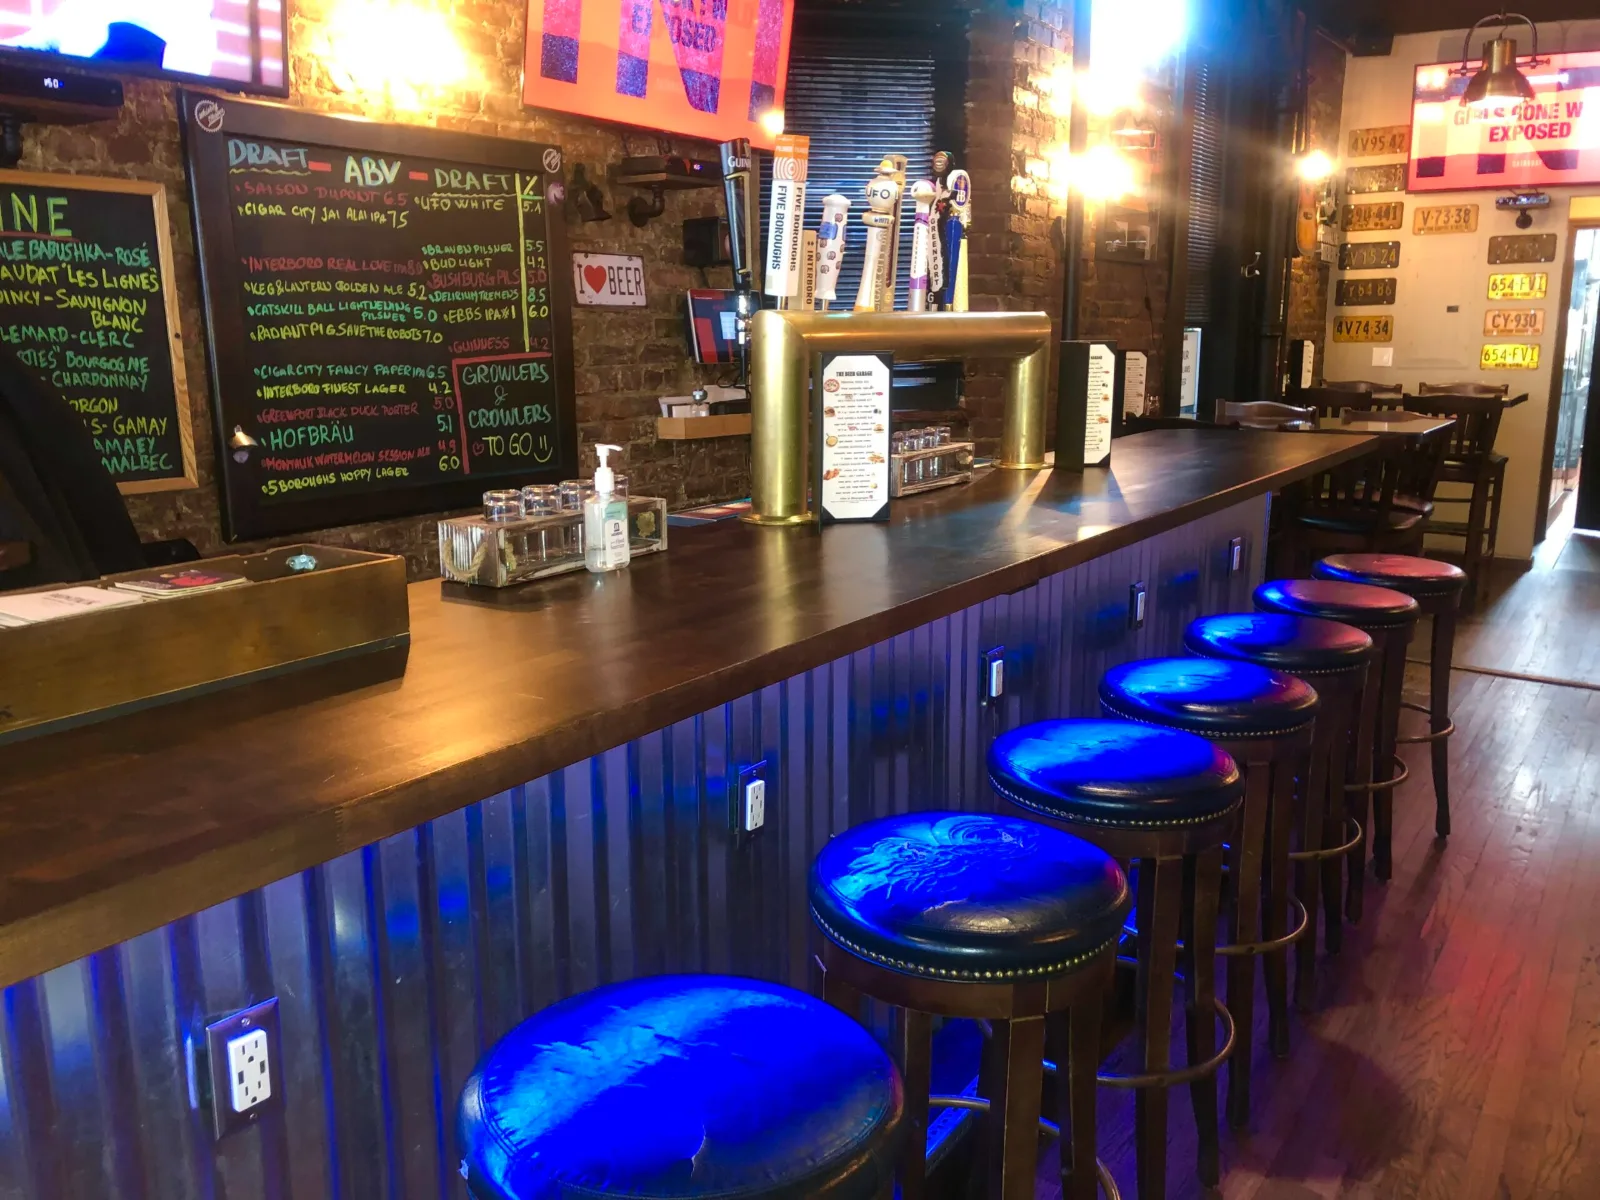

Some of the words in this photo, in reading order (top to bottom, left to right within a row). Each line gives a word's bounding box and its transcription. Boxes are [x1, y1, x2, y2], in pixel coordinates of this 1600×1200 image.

[1489, 122, 1572, 142] EXPOSED
[228, 139, 309, 169] DRAFT
[344, 155, 401, 187] ABV
[434, 168, 511, 191] DRAFT
[523, 175, 538, 195] %
[244, 181, 309, 196] SAISON
[314, 186, 380, 203] DUPONT
[776, 185, 788, 210] FIVE
[866, 186, 891, 200] UFO
[244, 203, 286, 216] CIGAR
[292, 206, 316, 225] CITY
[321, 207, 341, 222] JAI
[347, 207, 368, 222] ALAI
[370, 210, 388, 225] IPA
[455, 199, 505, 212] WHITE
[771, 212, 785, 270] BOROUGHS
[930, 218, 940, 287] GREENPORT
[430, 258, 457, 271] BUD
[576, 263, 585, 294] I
[607, 265, 643, 296] BEER
[806, 250, 815, 305] INTERBORO
[383, 284, 404, 295] ALE
[56, 288, 147, 316] SAUVIGNON
[254, 303, 305, 317] CATSKILL
[307, 303, 335, 317] BALL
[90, 310, 144, 334] BLANC
[51, 370, 148, 393] CHARDONNAY
[327, 364, 369, 377] FANCY
[374, 364, 412, 376] PAPER
[462, 362, 550, 385] GROWLERS
[365, 384, 407, 394] LAGER
[428, 380, 452, 395] 4.2
[113, 415, 168, 436] GAMAY
[468, 403, 552, 429] CROWLERS
[270, 420, 355, 451] HOFBRÄU
[481, 435, 505, 456] TO
[508, 432, 533, 456] GO
[101, 453, 173, 475] MALBEC
[339, 467, 372, 483] HOPPY
[375, 466, 410, 479] LAGER
